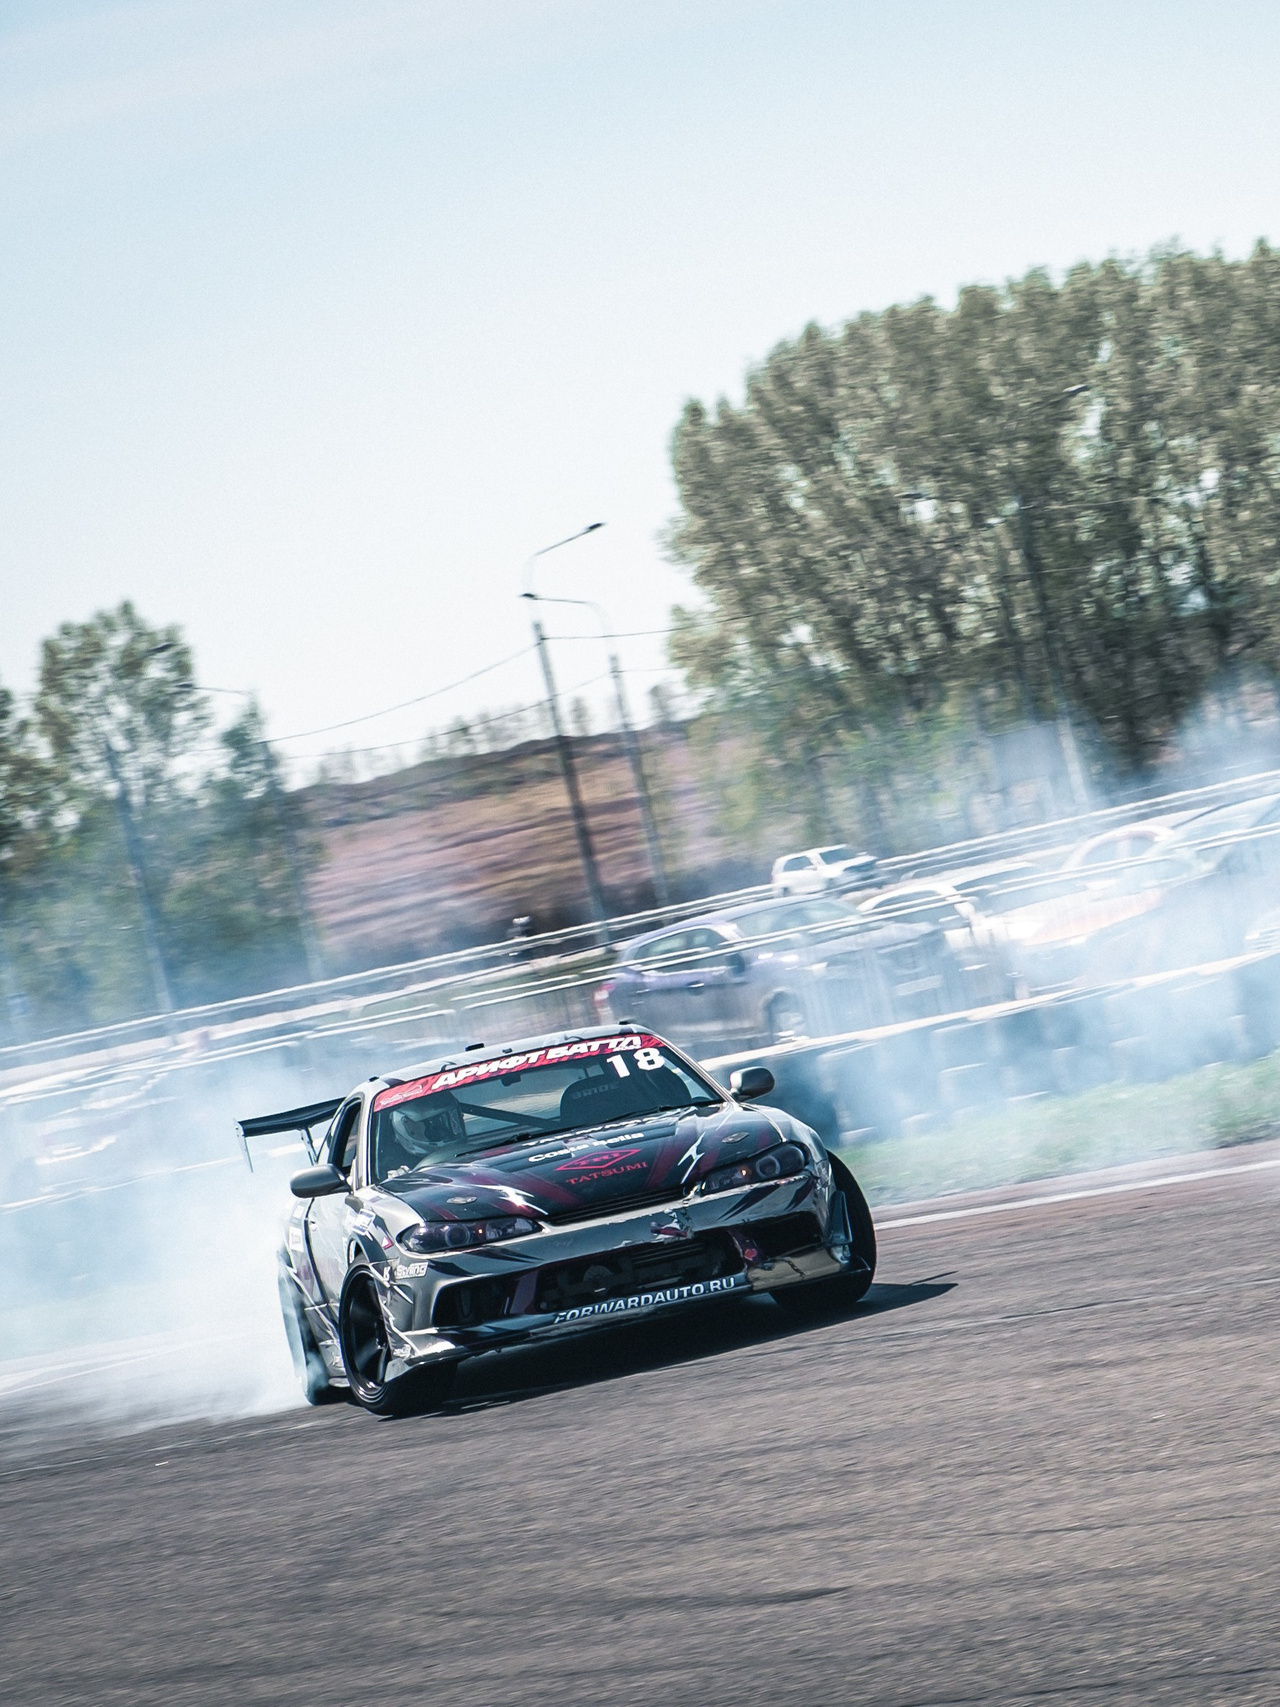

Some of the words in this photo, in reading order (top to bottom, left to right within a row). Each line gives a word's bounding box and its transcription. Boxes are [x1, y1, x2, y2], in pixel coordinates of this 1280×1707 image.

[431, 1050, 546, 1090] ДРИФТ
[606, 1048, 666, 1078] 18
[565, 1161, 649, 1185] TATSUMI
[553, 1276, 736, 1324] FORWARDAUTO.RU
